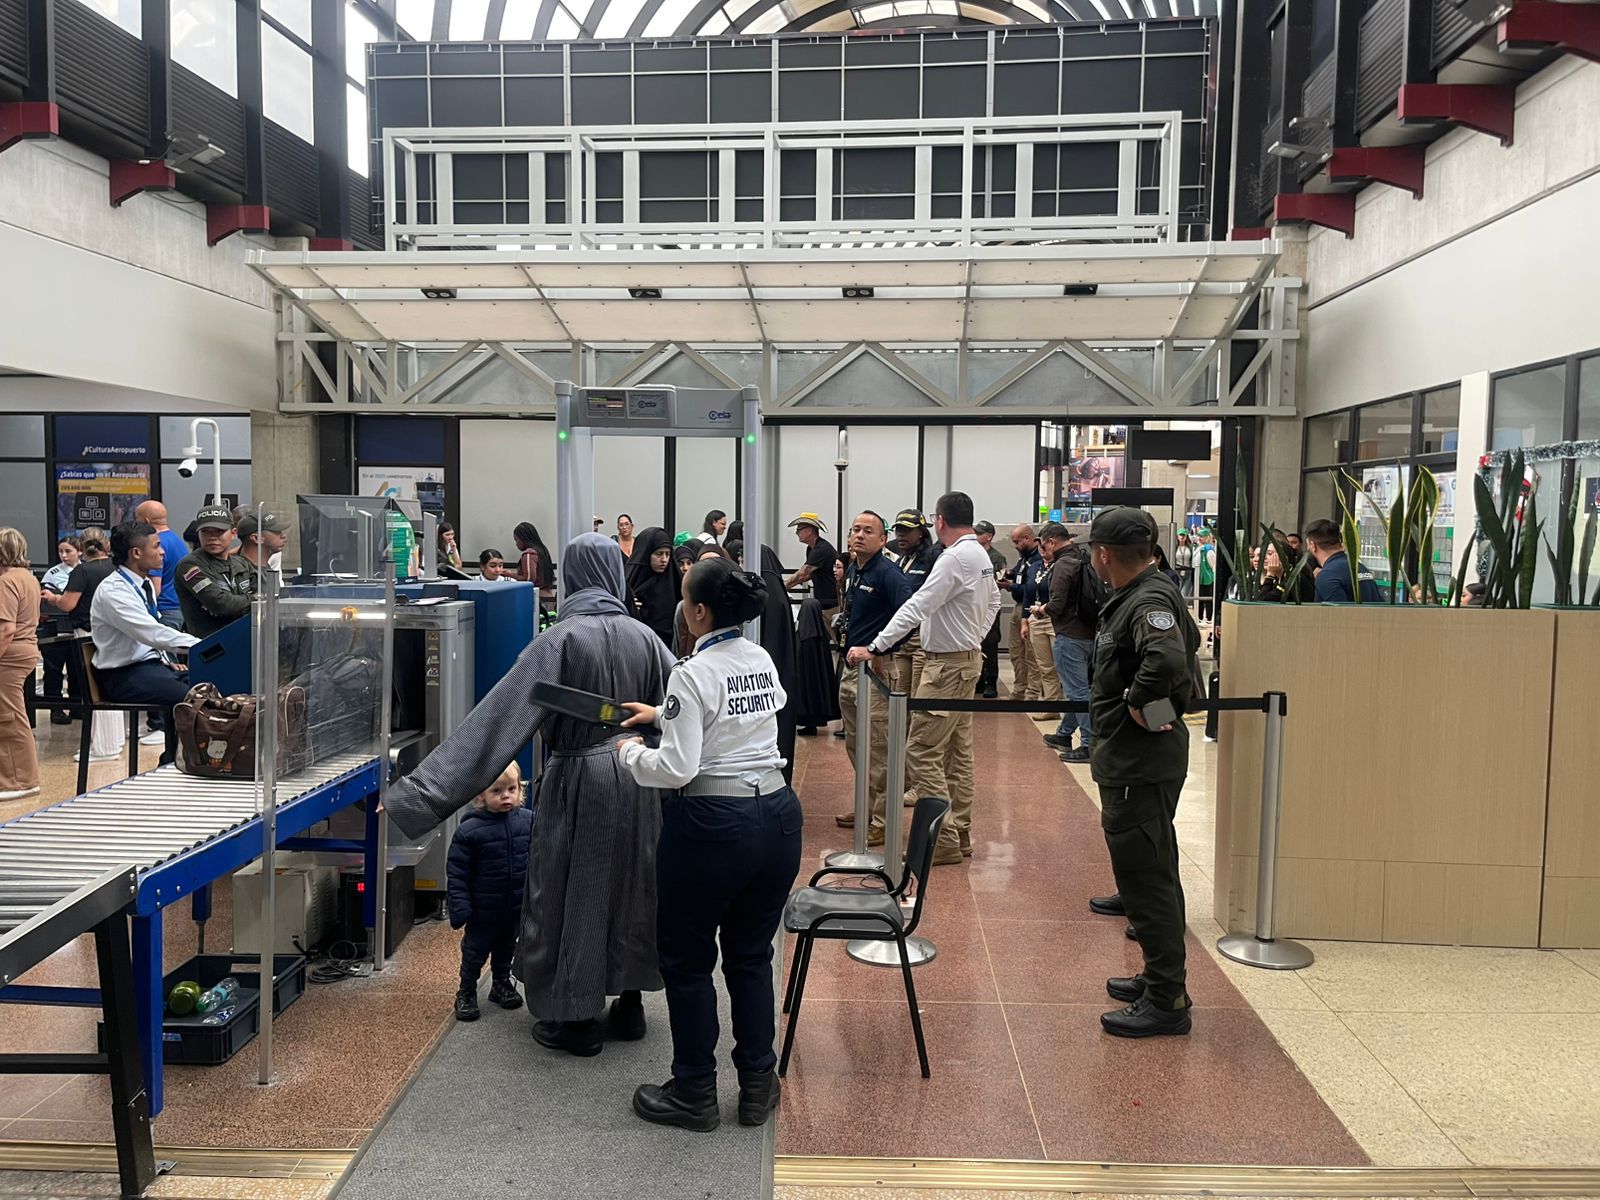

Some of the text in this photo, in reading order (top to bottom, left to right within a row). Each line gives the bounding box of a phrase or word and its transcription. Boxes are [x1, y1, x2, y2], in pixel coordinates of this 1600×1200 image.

[83, 446, 146, 456] #CulturaAeropuerto
[112, 471, 146, 480] Aeropuerto
[727, 671, 774, 694] AVIATION
[728, 692, 776, 715] SECURITY
